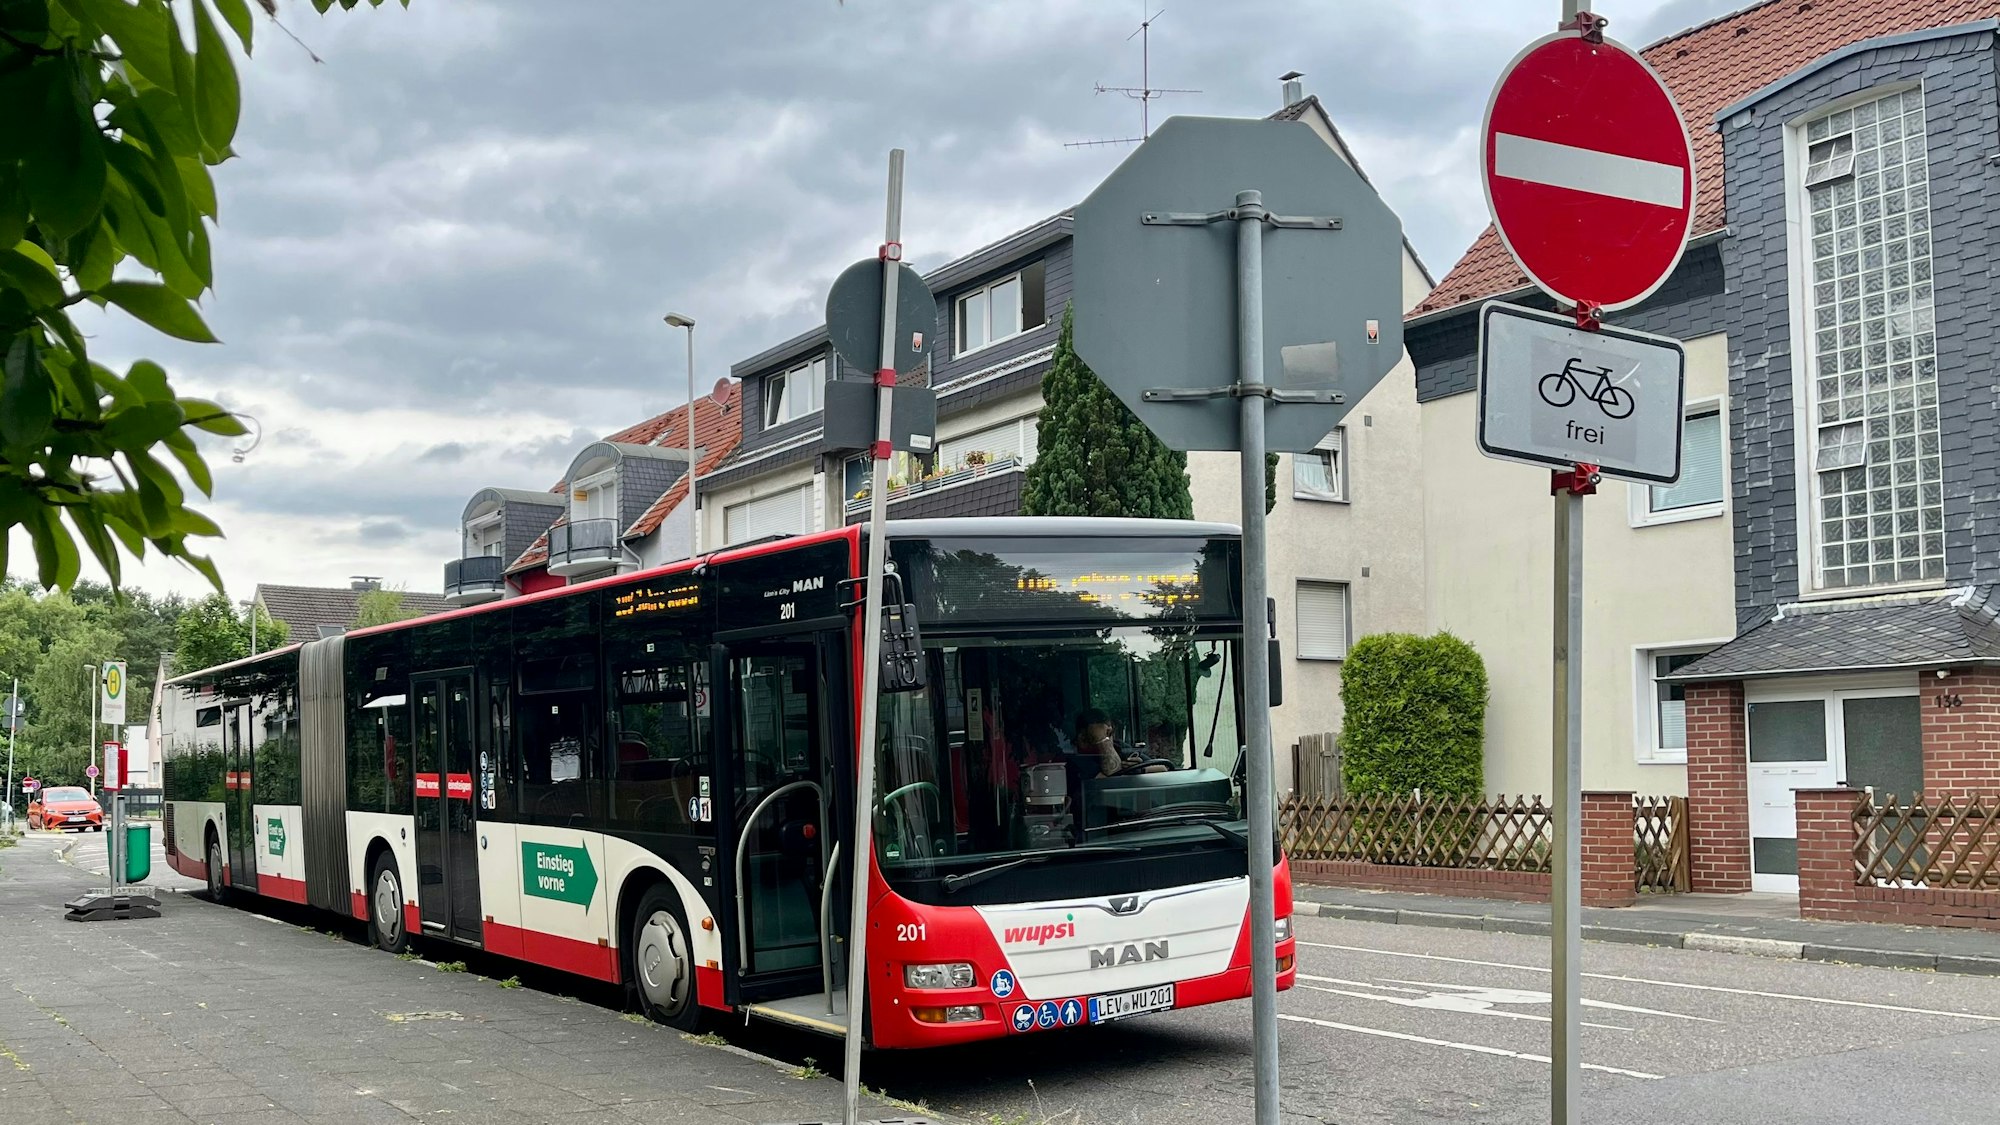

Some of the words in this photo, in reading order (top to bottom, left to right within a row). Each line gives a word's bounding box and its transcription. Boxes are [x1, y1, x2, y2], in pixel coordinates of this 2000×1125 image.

[1566, 420, 1604, 444] frei
[793, 576, 824, 593] MAN
[780, 602, 795, 620] 201
[1935, 694, 1962, 708] 136
[536, 852, 574, 876] Einstieg
[538, 875, 565, 892] vorne
[897, 923, 926, 942] 201
[1004, 913, 1075, 945] wupsi
[1089, 939, 1169, 968] MAN
[1099, 997, 1122, 1017] LEV
[1131, 992, 1147, 1010] WU
[1150, 987, 1172, 1006] 201
